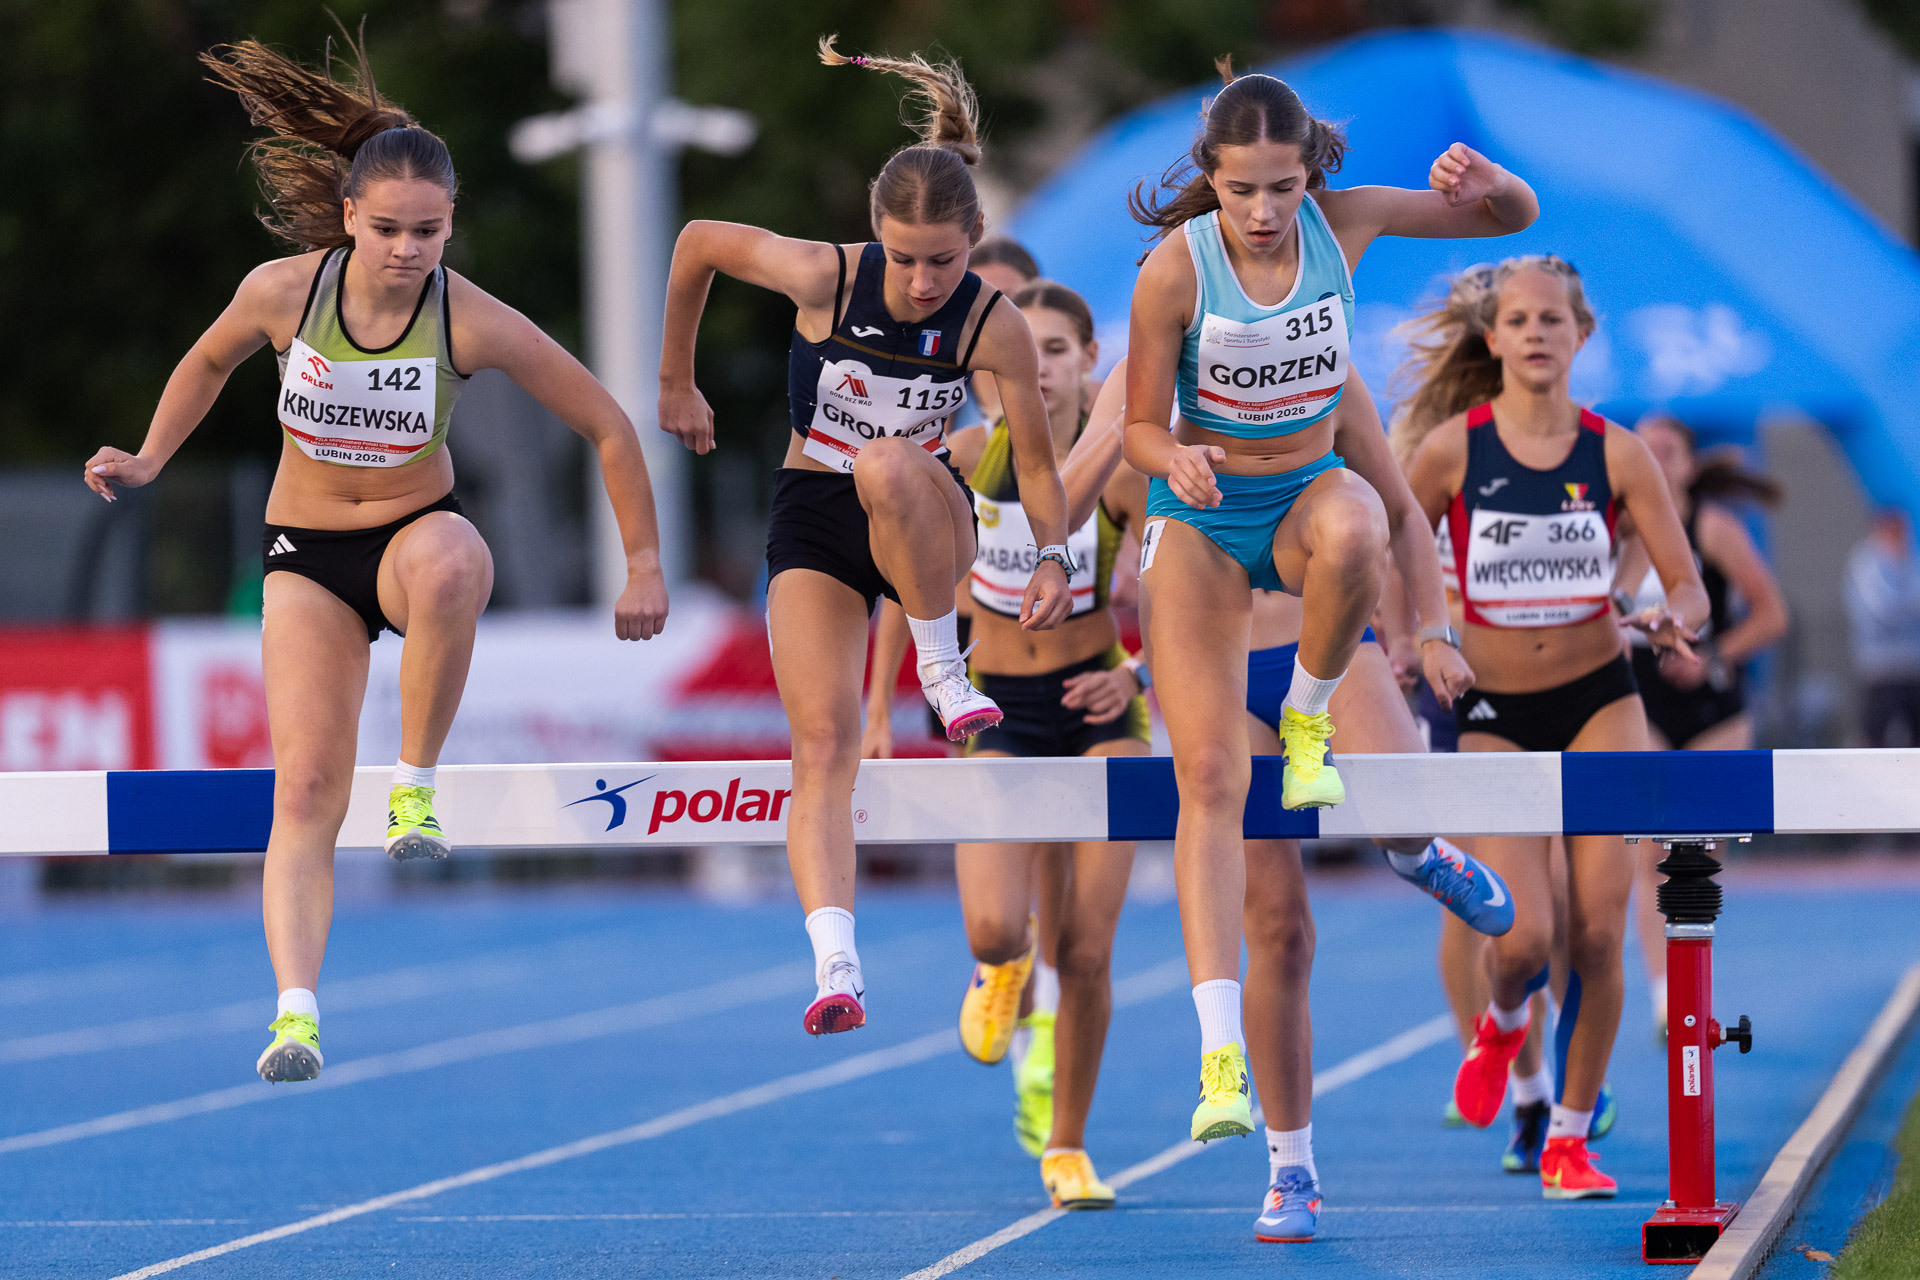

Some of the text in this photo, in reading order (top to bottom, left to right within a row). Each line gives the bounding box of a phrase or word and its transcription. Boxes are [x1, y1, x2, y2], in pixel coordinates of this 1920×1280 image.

[1224, 331, 1260, 339] Ministerstwo
[1285, 306, 1333, 342] 315
[367, 366, 421, 391] 142
[1209, 345, 1337, 389] GORZEŃ
[300, 371, 334, 391] ORLEN
[283, 388, 428, 434] KRUSZEWSKA
[829, 390, 873, 407] DOM BEZ WAD
[896, 386, 963, 411] 1159
[1237, 405, 1306, 421] LUBIN 2026
[315, 448, 386, 463] LUBIN 2026
[1479, 519, 1596, 545] 4F 366
[1474, 557, 1601, 589] WIĘCKOWSKA
[1687, 1063, 1697, 1094] polanik
